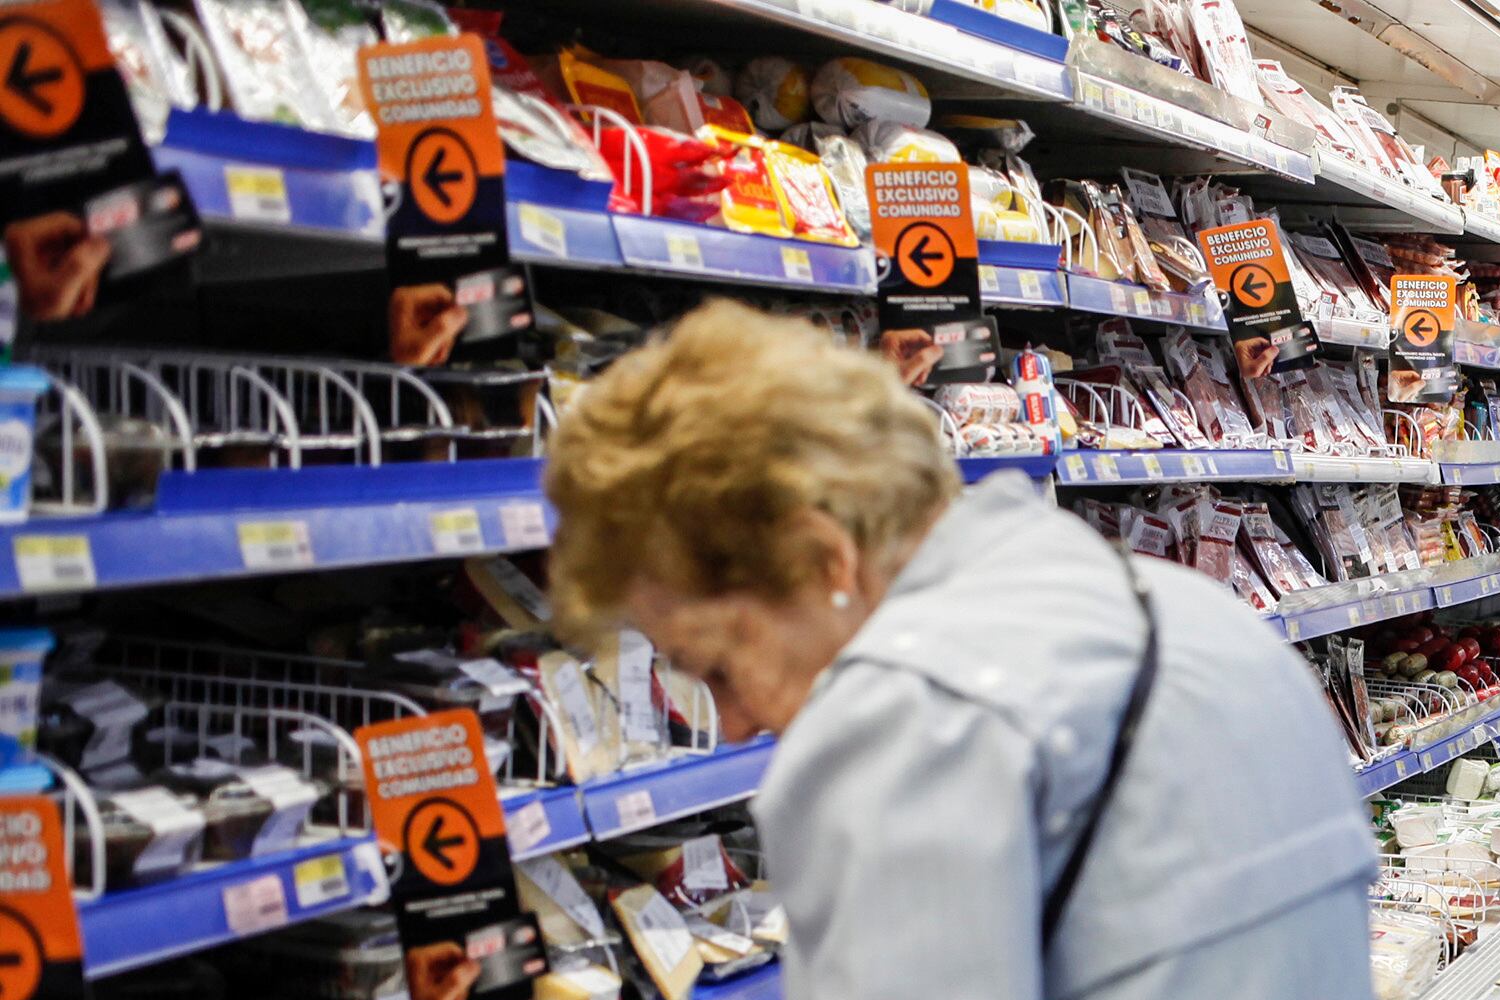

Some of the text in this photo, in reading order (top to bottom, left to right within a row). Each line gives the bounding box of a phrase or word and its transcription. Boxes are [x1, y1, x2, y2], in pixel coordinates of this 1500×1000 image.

[367, 48, 472, 78] BENEFICIO
[373, 74, 477, 102] EXCLUSIVO
[874, 171, 958, 187] BENEFICIO
[876, 188, 960, 203] EXCLUSIVO
[878, 204, 961, 217] COMUNIDAD
[1207, 226, 1267, 245] BENEFICIO
[1210, 238, 1270, 256] EXCLUSIVO
[1214, 248, 1273, 265] COMUNIDAD
[1397, 281, 1448, 290] BENEFICIO
[1397, 290, 1447, 299] EXCLUSIVO
